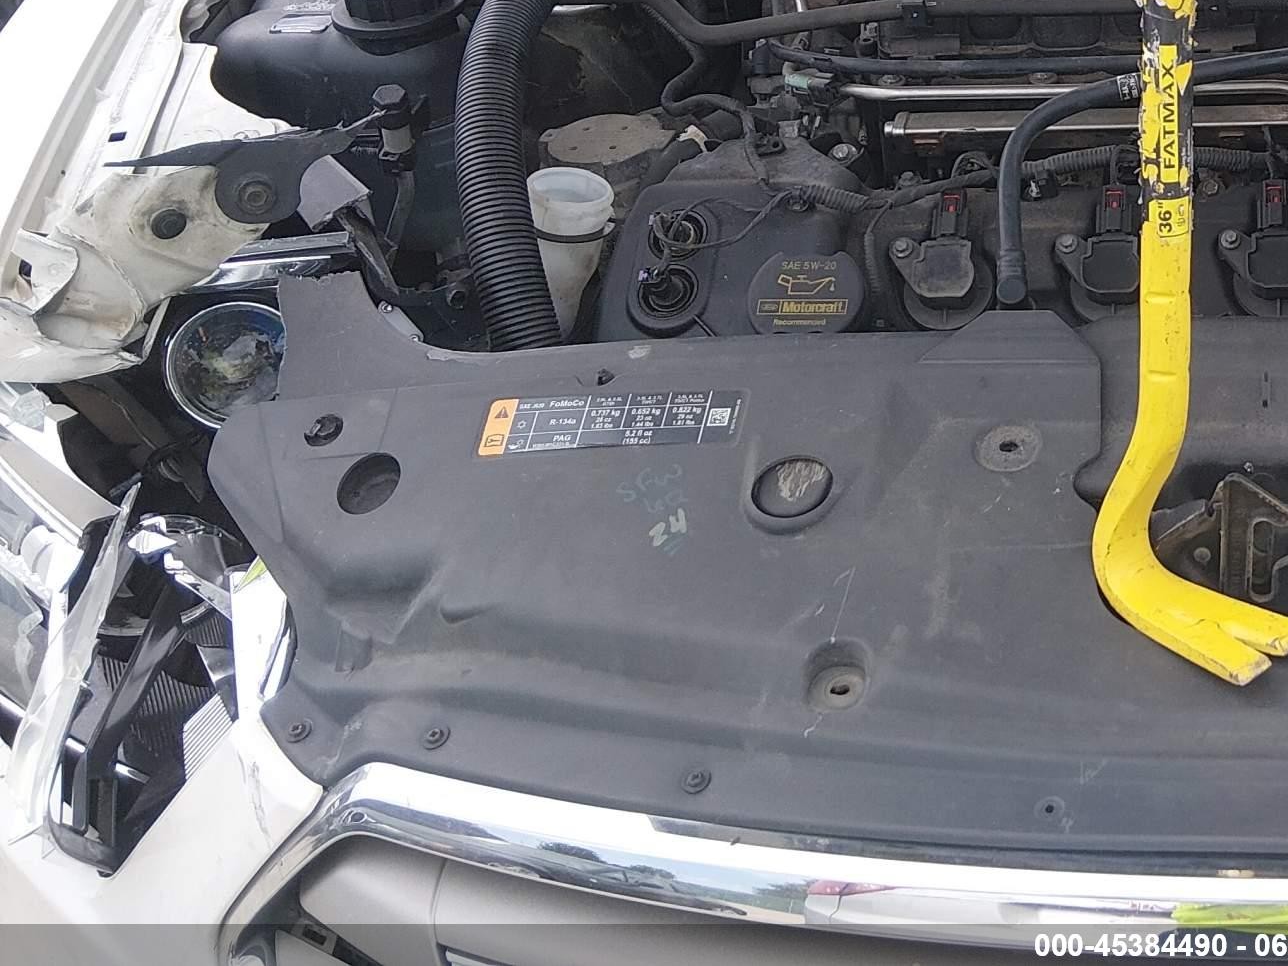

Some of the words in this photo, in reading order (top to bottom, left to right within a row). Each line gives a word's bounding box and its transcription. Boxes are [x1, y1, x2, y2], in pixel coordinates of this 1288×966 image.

[1161, 63, 1176, 169] FATMAX
[1157, 201, 1173, 233] 36"
[782, 261, 801, 270] SAE
[803, 260, 837, 270] 5W-20
[782, 301, 843, 313] Motorcraft
[549, 399, 585, 408] FoMoCo
[611, 408, 621, 417] kg
[651, 407, 661, 415] kg
[692, 406, 702, 414] kg
[552, 434, 571, 442] PAG
